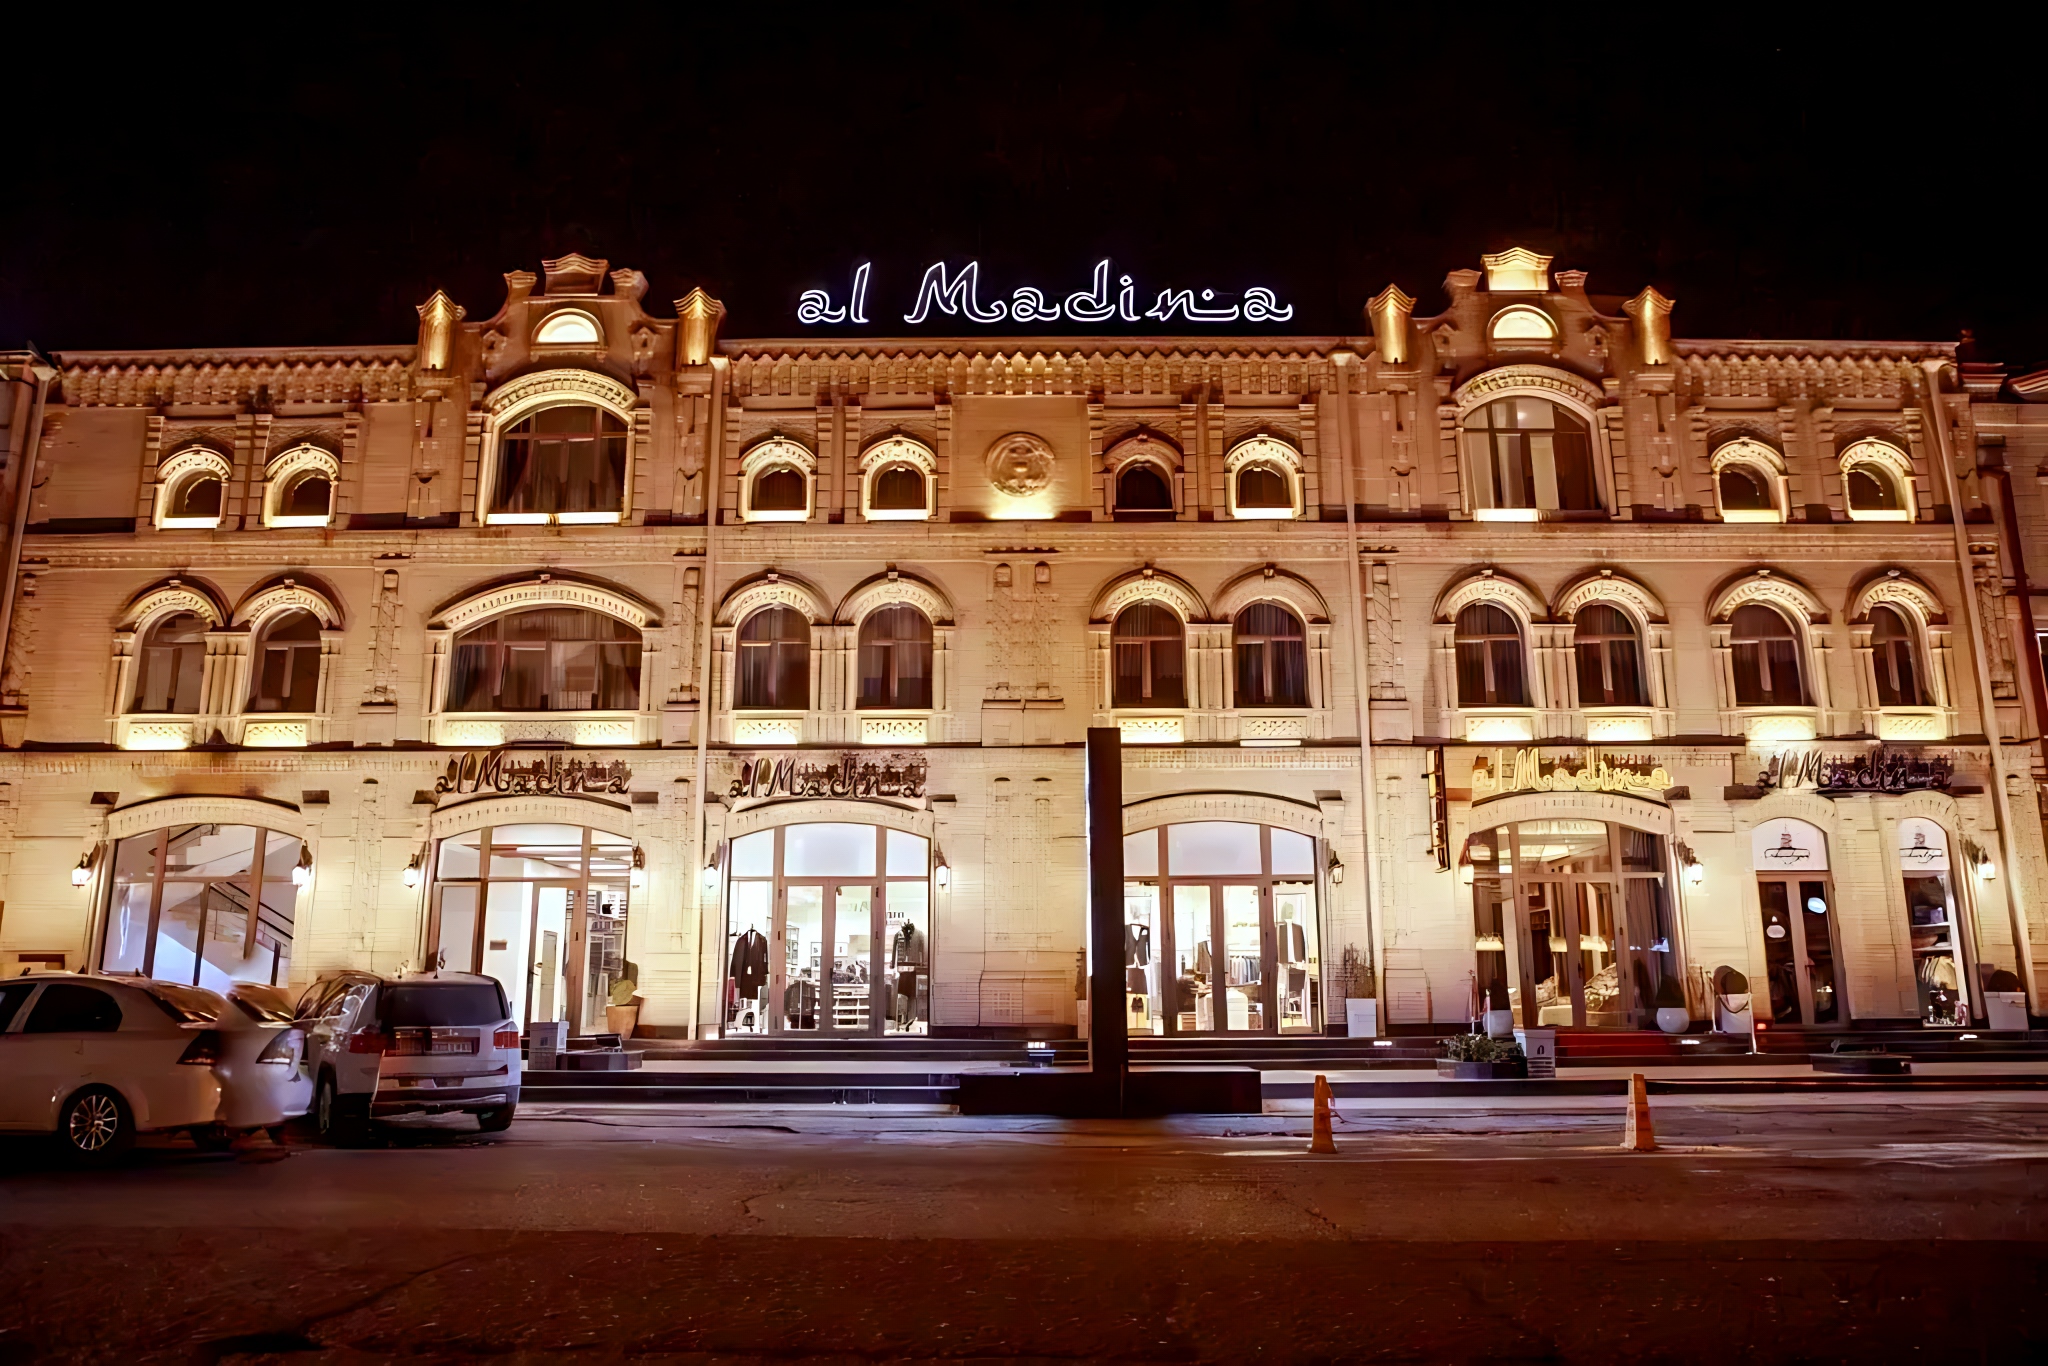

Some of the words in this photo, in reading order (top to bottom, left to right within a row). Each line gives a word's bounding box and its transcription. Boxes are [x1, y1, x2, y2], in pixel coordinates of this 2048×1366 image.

[798, 261, 871, 323] al
[903, 259, 1294, 323] Madina
[435, 752, 469, 794] al
[473, 750, 630, 794] Madina
[728, 757, 762, 798] al
[765, 756, 926, 798] Madina
